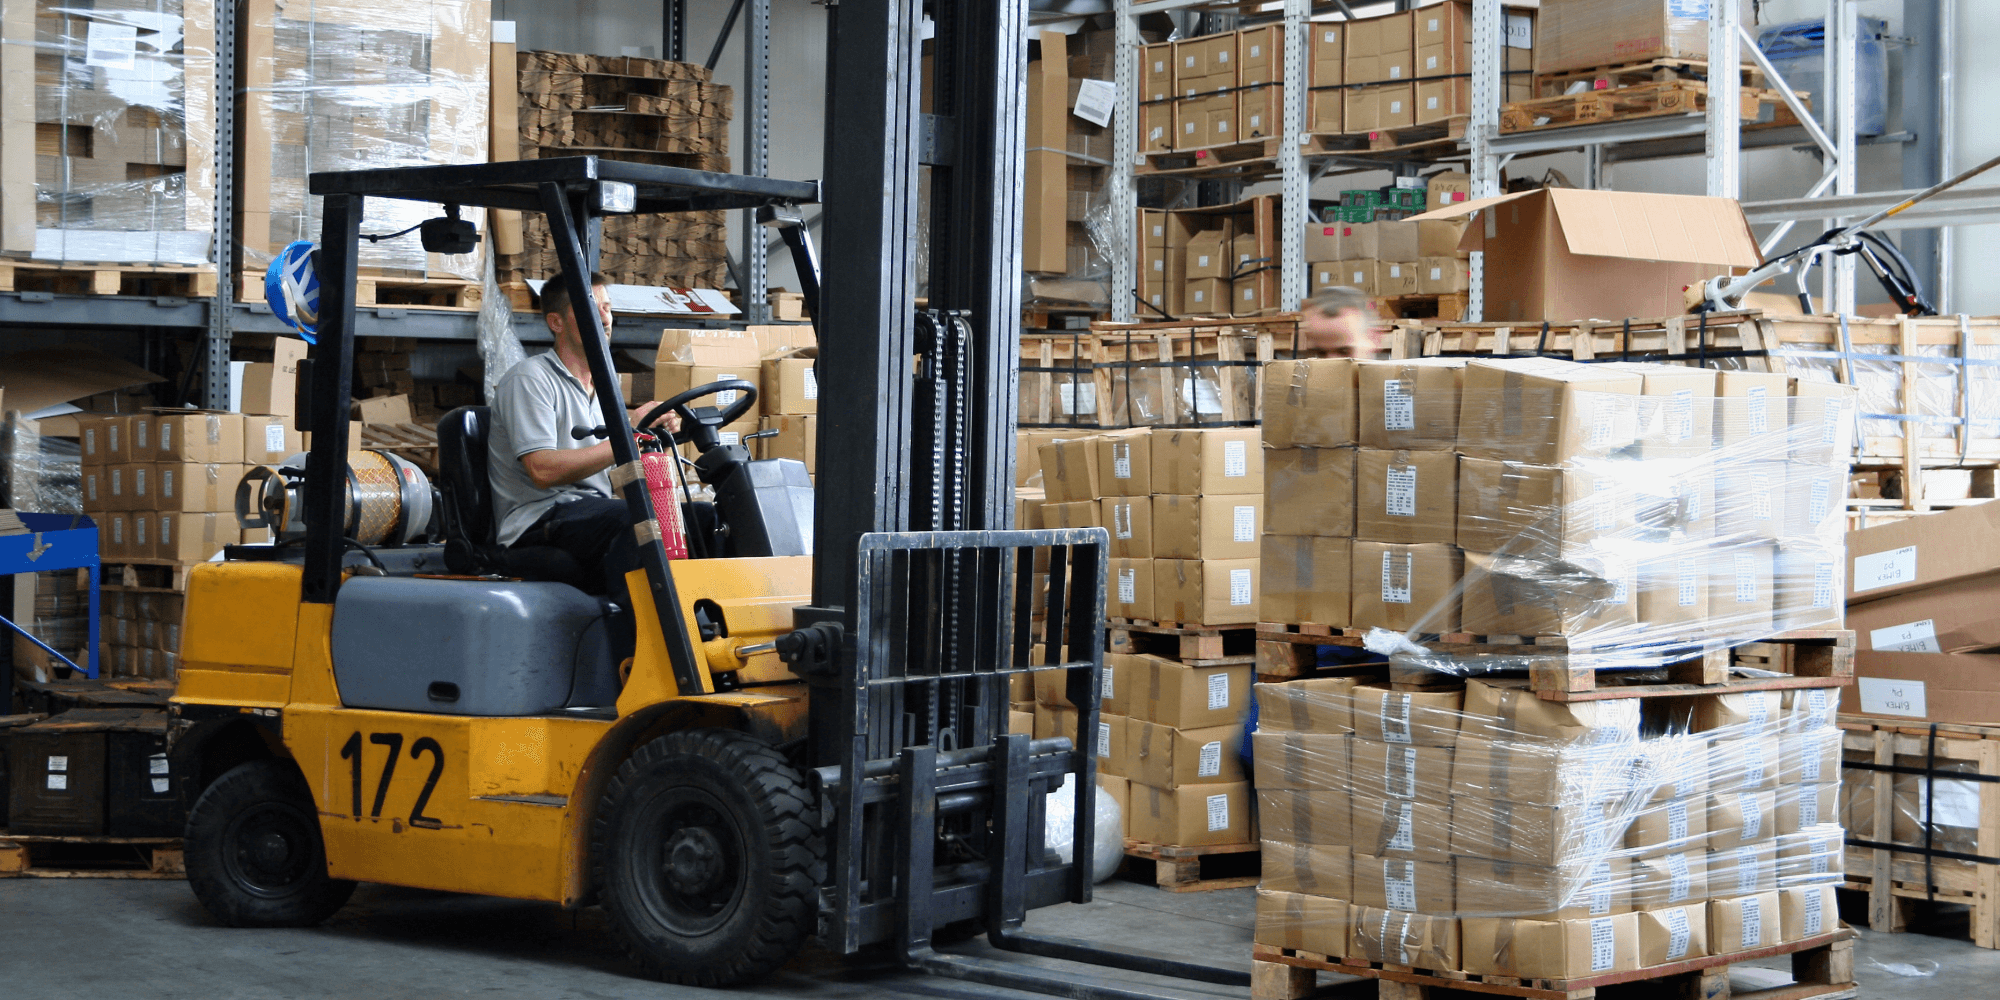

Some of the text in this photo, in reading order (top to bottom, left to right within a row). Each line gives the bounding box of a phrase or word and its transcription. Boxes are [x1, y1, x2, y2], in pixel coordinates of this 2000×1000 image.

[1877, 569, 1901, 581] BIMEX
[1885, 701, 1910, 711] BIMEX
[340, 731, 444, 830] 172
